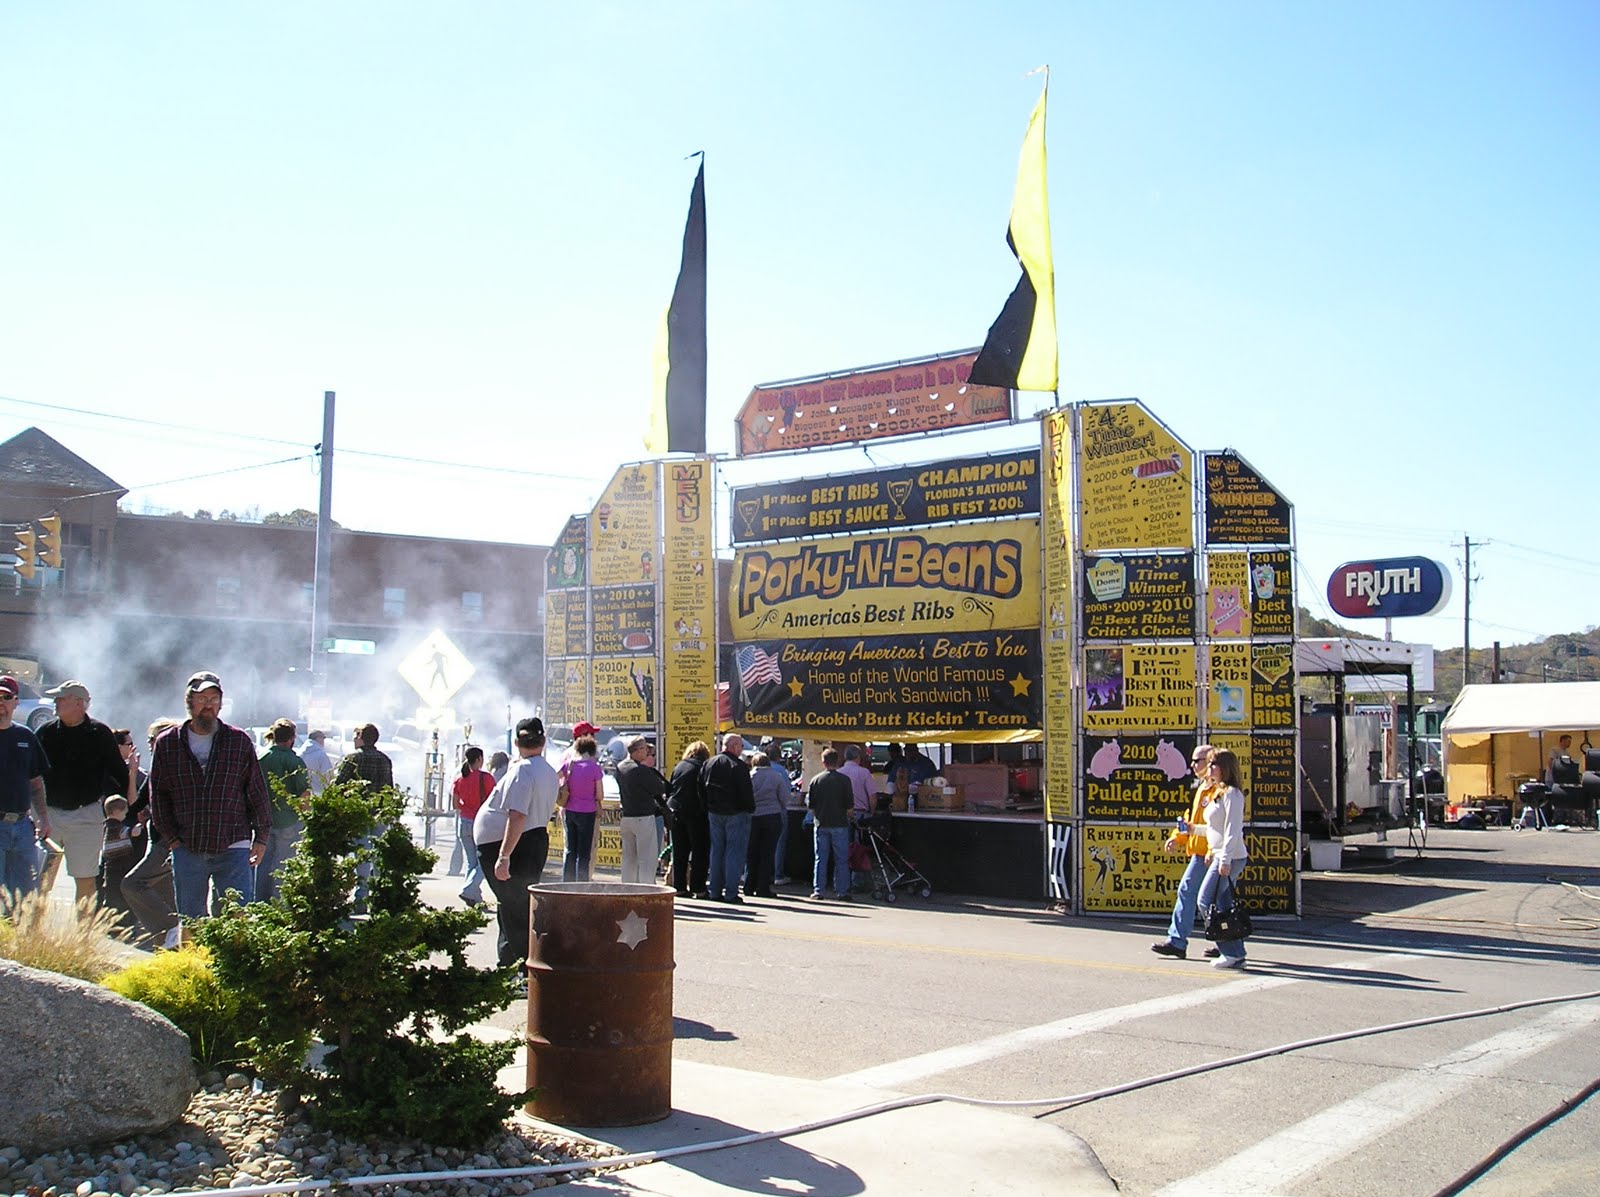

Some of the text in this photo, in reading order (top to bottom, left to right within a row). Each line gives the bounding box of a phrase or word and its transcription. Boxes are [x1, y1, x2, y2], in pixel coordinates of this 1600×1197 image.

[886, 395, 920, 407] Nugget
[858, 412, 878, 422] Best
[1098, 406, 1117, 429] 4
[781, 412, 958, 446] NUGGET COOK-OFF
[1088, 424, 1135, 444] Time
[1085, 430, 1156, 460] Winner!
[1085, 445, 1176, 472] Columbus Jazz Fest
[918, 459, 1036, 488] CHAMPION
[1149, 476, 1172, 489] 2007
[672, 464, 703, 523] MENU
[780, 494, 807, 506] Place
[811, 486, 844, 505] BEST
[847, 482, 880, 501] RIBS
[925, 481, 1028, 502] FLORIDA'S NATIONAL
[1209, 490, 1277, 508] WINNER
[927, 504, 951, 518] RIB
[952, 500, 984, 516] FEST
[779, 516, 807, 528] Place
[809, 508, 842, 527] BEST
[846, 504, 889, 525] SAUCE
[1150, 511, 1175, 523] 2006
[1258, 517, 1280, 525] SAUCE
[1264, 526, 1289, 534] CHOICE
[1154, 556, 1164, 570] 3
[1208, 554, 1228, 562] Miss
[1255, 552, 1285, 563] 2010
[740, 537, 1021, 616] Porky-N-Beans
[1095, 567, 1120, 578] Fargo
[1137, 569, 1180, 581] Time
[1234, 570, 1245, 578] of
[1275, 570, 1290, 586] 1st
[1096, 577, 1121, 587] Dome
[1128, 580, 1188, 595] Winner!
[1230, 579, 1247, 587] Pig
[1346, 567, 1421, 606] FRUTH
[609, 589, 635, 601] 2010
[1085, 596, 1194, 613] 2008 2009 2010
[1258, 599, 1287, 611] Best
[594, 612, 614, 622] Best
[782, 600, 955, 629] America's Best Ribs
[1104, 613, 1175, 625] Best Ribs
[1254, 612, 1291, 625] Sauce
[594, 622, 614, 631] Ribs
[627, 619, 651, 629] Place
[1087, 625, 1192, 637] Critic's Choice
[593, 632, 624, 643] Critic's
[593, 642, 623, 653] Choice
[782, 635, 1028, 666] Bringing America's Best to You
[1137, 646, 1180, 656] 2010
[1213, 645, 1245, 653] 2010
[598, 661, 623, 673] 2010
[1211, 656, 1248, 668] Best
[1262, 659, 1280, 669] RIB
[808, 666, 1005, 685] Home of the World Famous
[1144, 667, 1182, 676] PLACE
[1211, 668, 1248, 681] Ribs
[607, 674, 628, 684] Place
[1125, 677, 1194, 691] BEST RIBS
[594, 686, 614, 697] Best
[614, 686, 632, 696] Ribs
[1254, 683, 1273, 692] 2010
[822, 686, 990, 705] Pulled Pork Sandwich !!!
[1125, 693, 1194, 708] BEST SAUCE
[1253, 692, 1292, 708] Best
[567, 705, 585, 713] Best
[594, 698, 642, 709] Best Sauce
[595, 713, 642, 722] Rochester, NY
[745, 710, 1028, 726] Best Rib Cookin' Butt Kickin' Team
[1087, 714, 1194, 726] NAPERVILLE, IL
[1254, 708, 1292, 725] Ribs
[1253, 737, 1292, 747] SUMMER
[1122, 744, 1155, 760] 2010
[1260, 748, 1284, 758] SLAM
[1115, 770, 1163, 781] 1st Place
[1087, 783, 1191, 804] Pulled Pork
[1254, 783, 1293, 793] PEOPLE'S
[1257, 796, 1289, 806] CHOICE
[1088, 805, 1161, 819] Cedar Rapids,
[1087, 828, 1144, 842] RHYTHM
[1122, 847, 1151, 873] 1ST
[1268, 865, 1293, 881] RIBS
[1112, 874, 1153, 892] BEST
[1244, 885, 1289, 896] NATIONAL
[1086, 898, 1172, 908] ST AUGUSTINE
